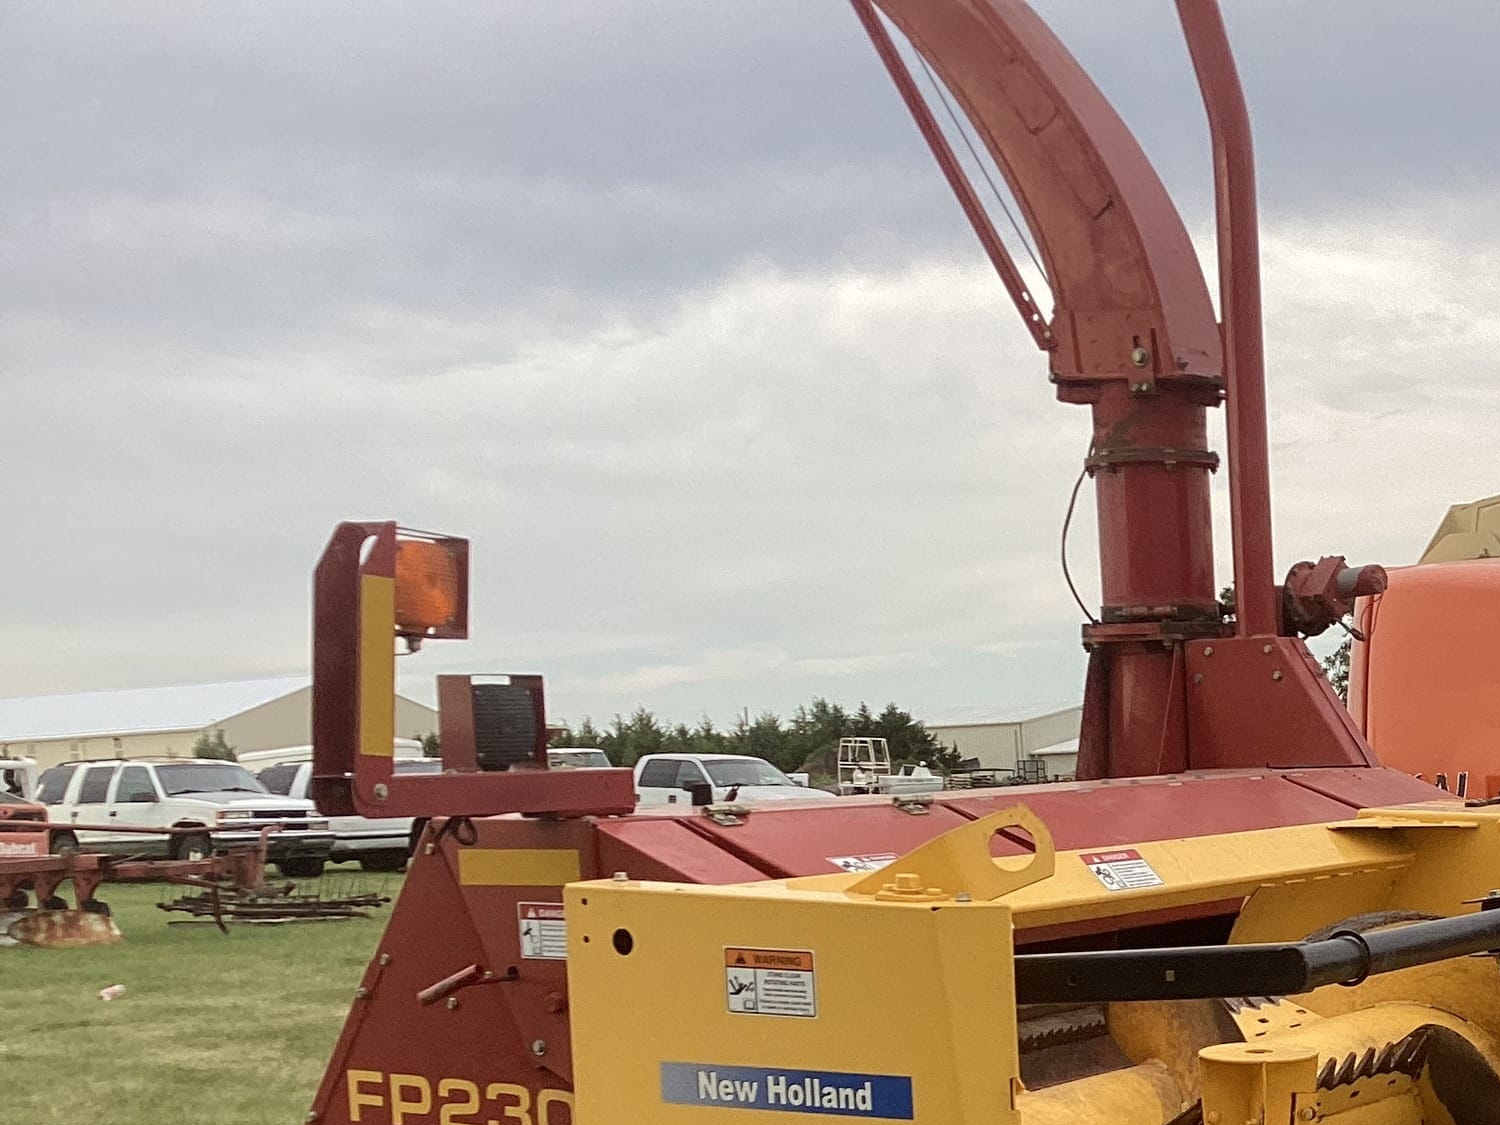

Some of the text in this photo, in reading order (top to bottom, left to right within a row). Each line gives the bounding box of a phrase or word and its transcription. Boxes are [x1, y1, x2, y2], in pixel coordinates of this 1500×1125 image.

[752, 955, 802, 966] WARNING
[697, 1070, 873, 1111] New Holland
